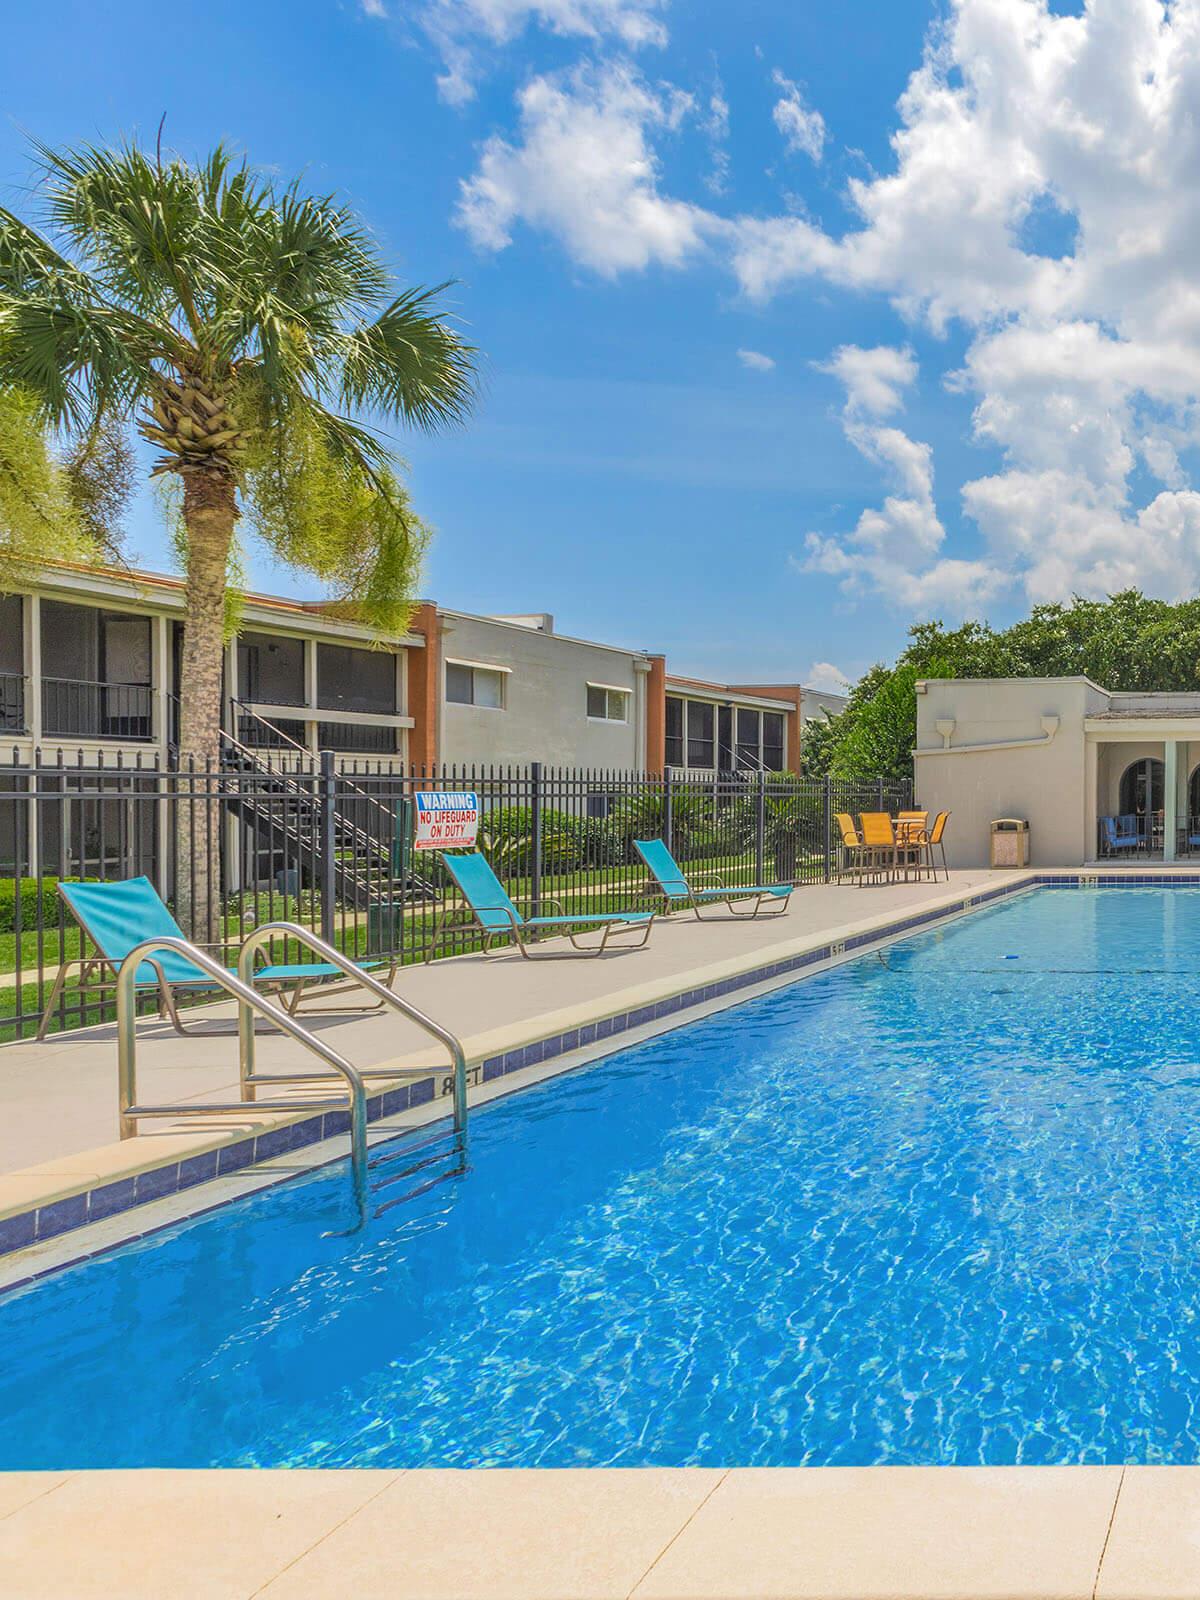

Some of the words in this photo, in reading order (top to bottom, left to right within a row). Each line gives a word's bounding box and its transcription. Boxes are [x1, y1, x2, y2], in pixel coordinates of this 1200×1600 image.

[421, 794, 473, 809] WARNING
[420, 811, 432, 824] NO
[435, 811, 476, 823] LIFEGUARD
[430, 825, 442, 838] ON
[445, 825, 465, 837] DUTY
[442, 1077, 454, 1095] 8
